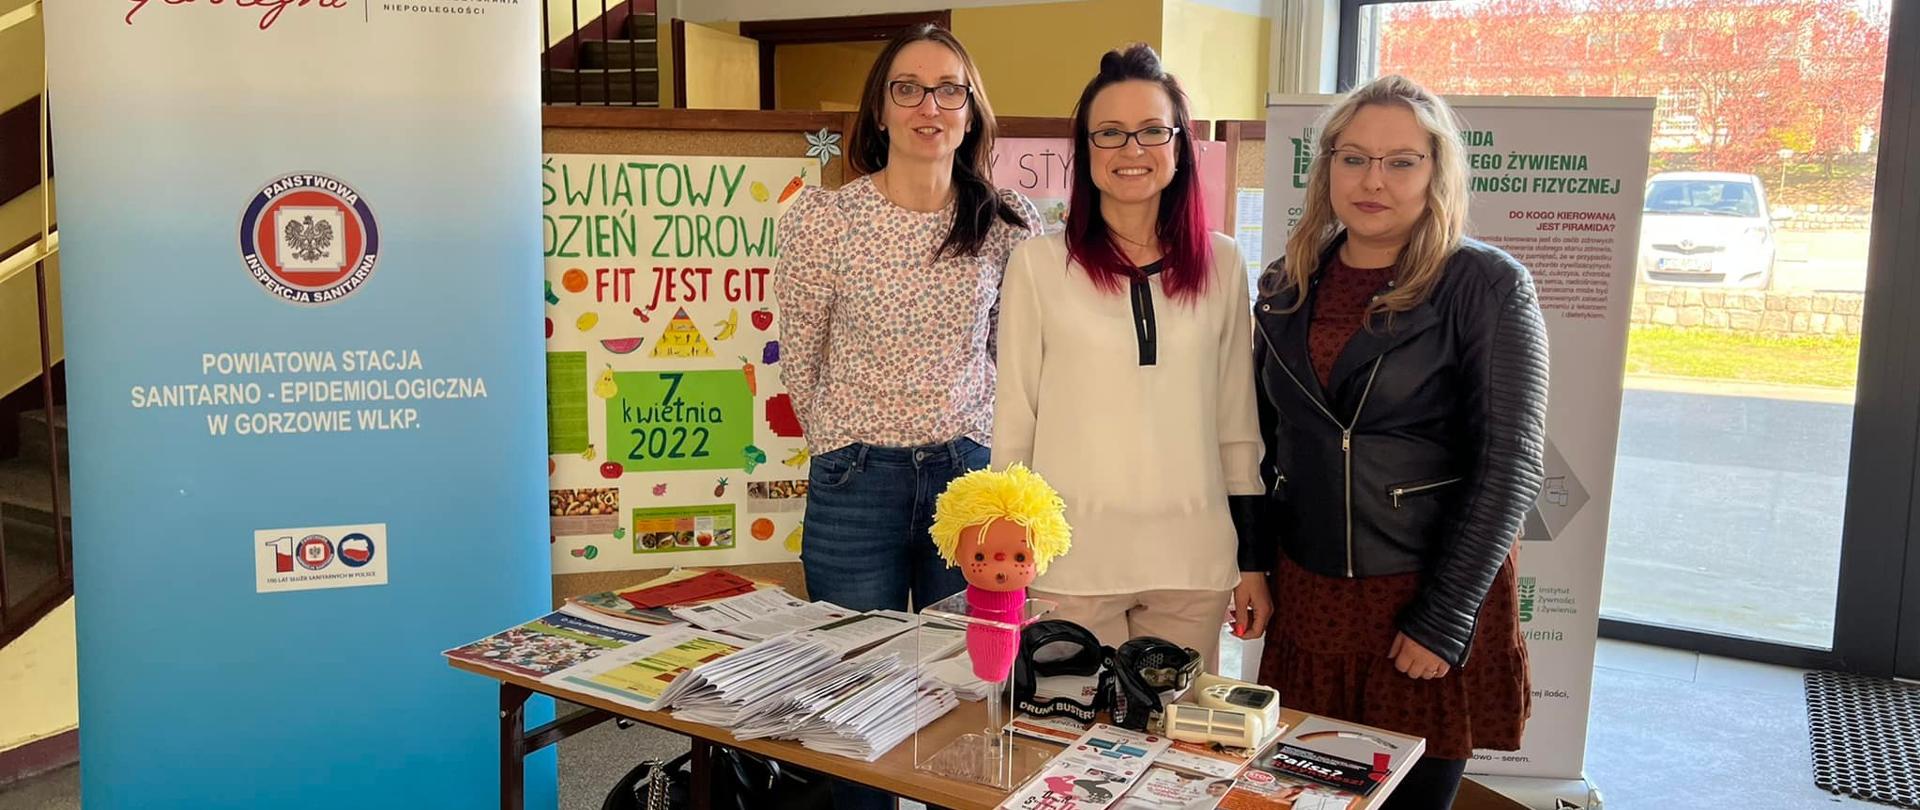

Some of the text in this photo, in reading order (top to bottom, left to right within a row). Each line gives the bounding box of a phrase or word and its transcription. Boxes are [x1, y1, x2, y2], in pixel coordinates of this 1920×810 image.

[383, 3, 485, 15] NIEPODLEGŁOŚCI
[1018, 151, 1075, 189] STY
[1467, 150, 1588, 171] EGO ŻYWIENIA
[263, 174, 359, 206] PAŃSTWOWA
[543, 157, 746, 207] ŚWIATOWY
[1532, 177, 1621, 194] FIZYCZNEJ
[1509, 210, 1616, 221] DO KOGO KIEROWANA
[1536, 221, 1616, 232] JEST PIRAMIDA?
[543, 209, 783, 258] DZIEŃ ZDROWI
[245, 253, 377, 302] INSPEKCJA SANITARNA
[595, 266, 771, 310] FIT JEST GIT
[202, 349, 423, 375] POWIATOWA STACJA
[131, 382, 262, 409] SANITARNO
[280, 377, 488, 403] EPIDEMIOLOGICZNA
[659, 373, 684, 407] 7
[208, 408, 421, 436] W GORZOWIE WLKP.
[622, 397, 723, 424] kwietnia
[628, 426, 710, 460] 2022
[1272, 753, 1344, 777] Palisz?
